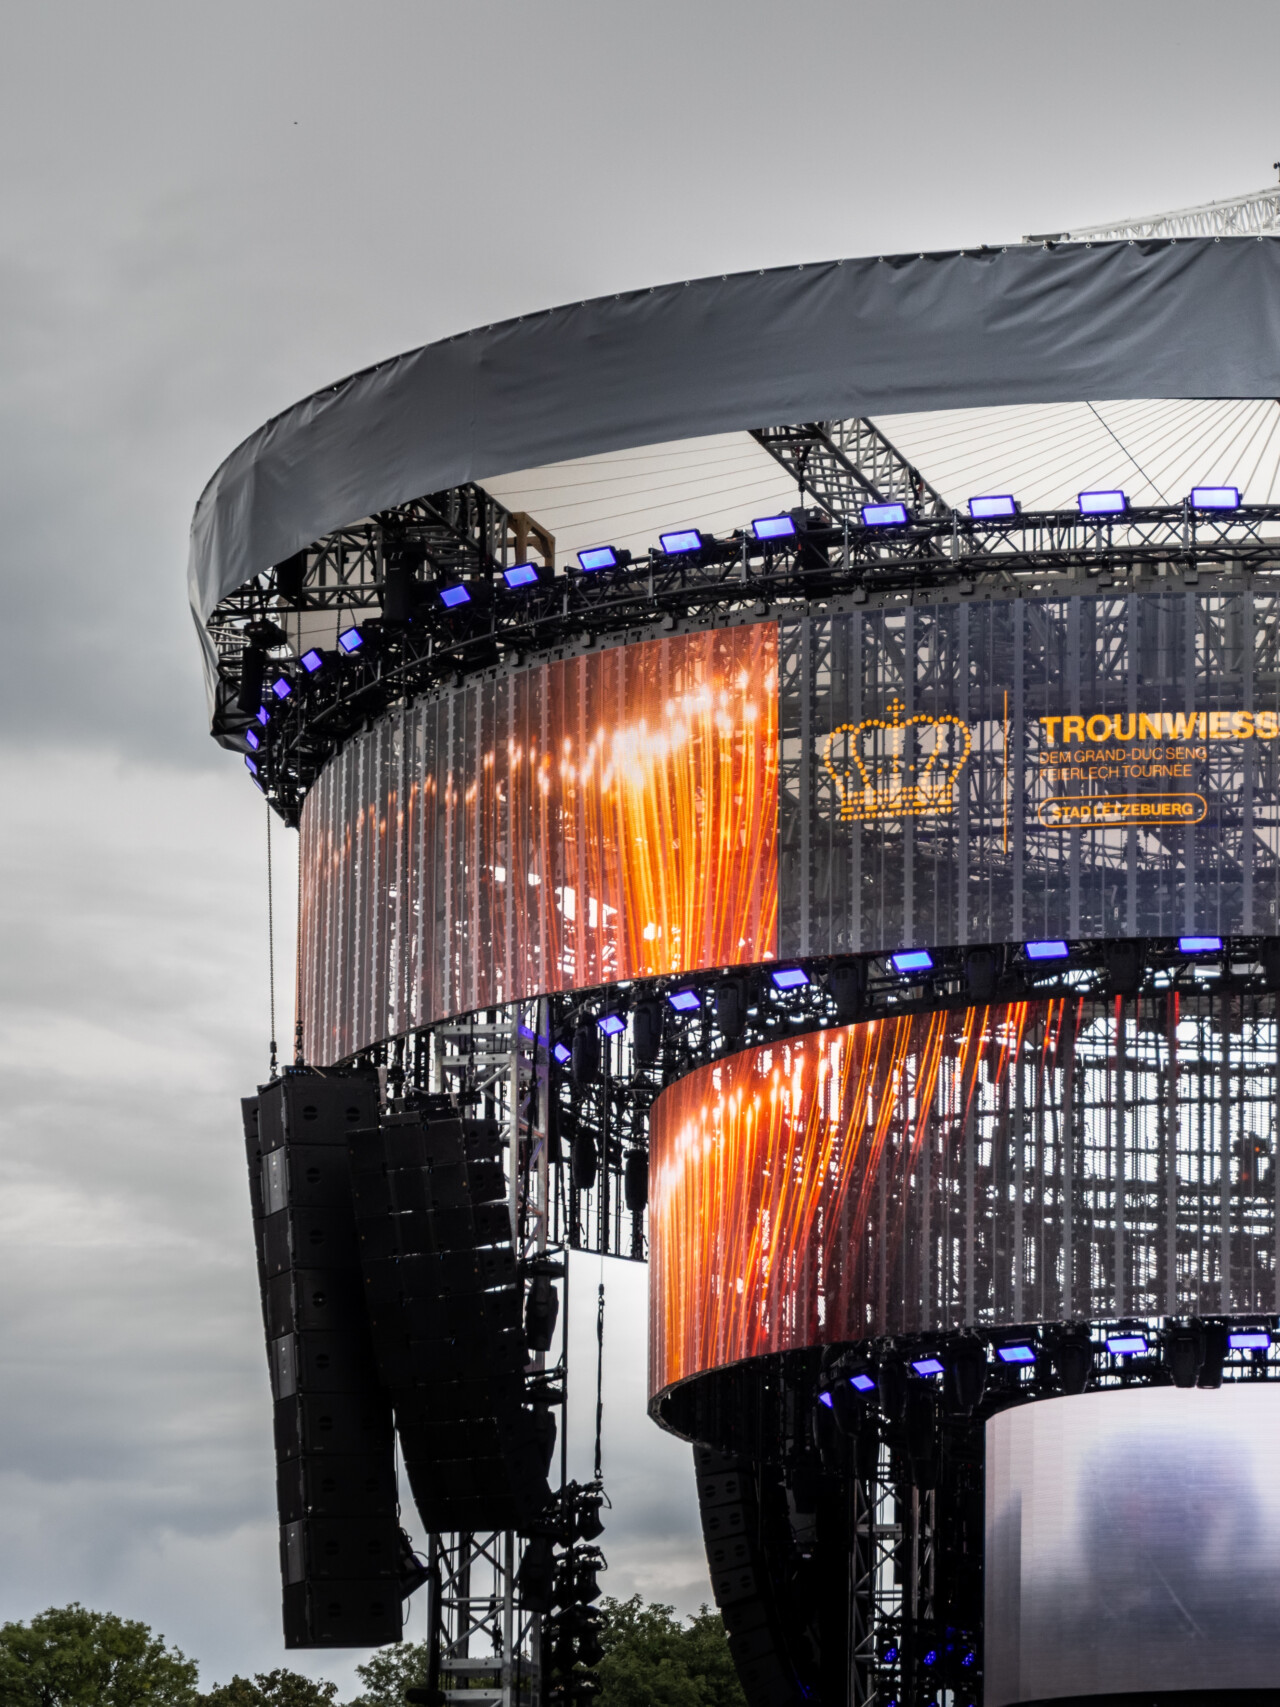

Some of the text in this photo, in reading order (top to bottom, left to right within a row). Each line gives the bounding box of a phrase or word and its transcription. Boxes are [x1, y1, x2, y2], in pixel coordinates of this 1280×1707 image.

[1039, 746, 1207, 764] DEM GRAND-DUC SENG
[1039, 766, 1119, 781] FEIERLECH
[1052, 802, 1193, 819] STAD LËTZEBUERG
